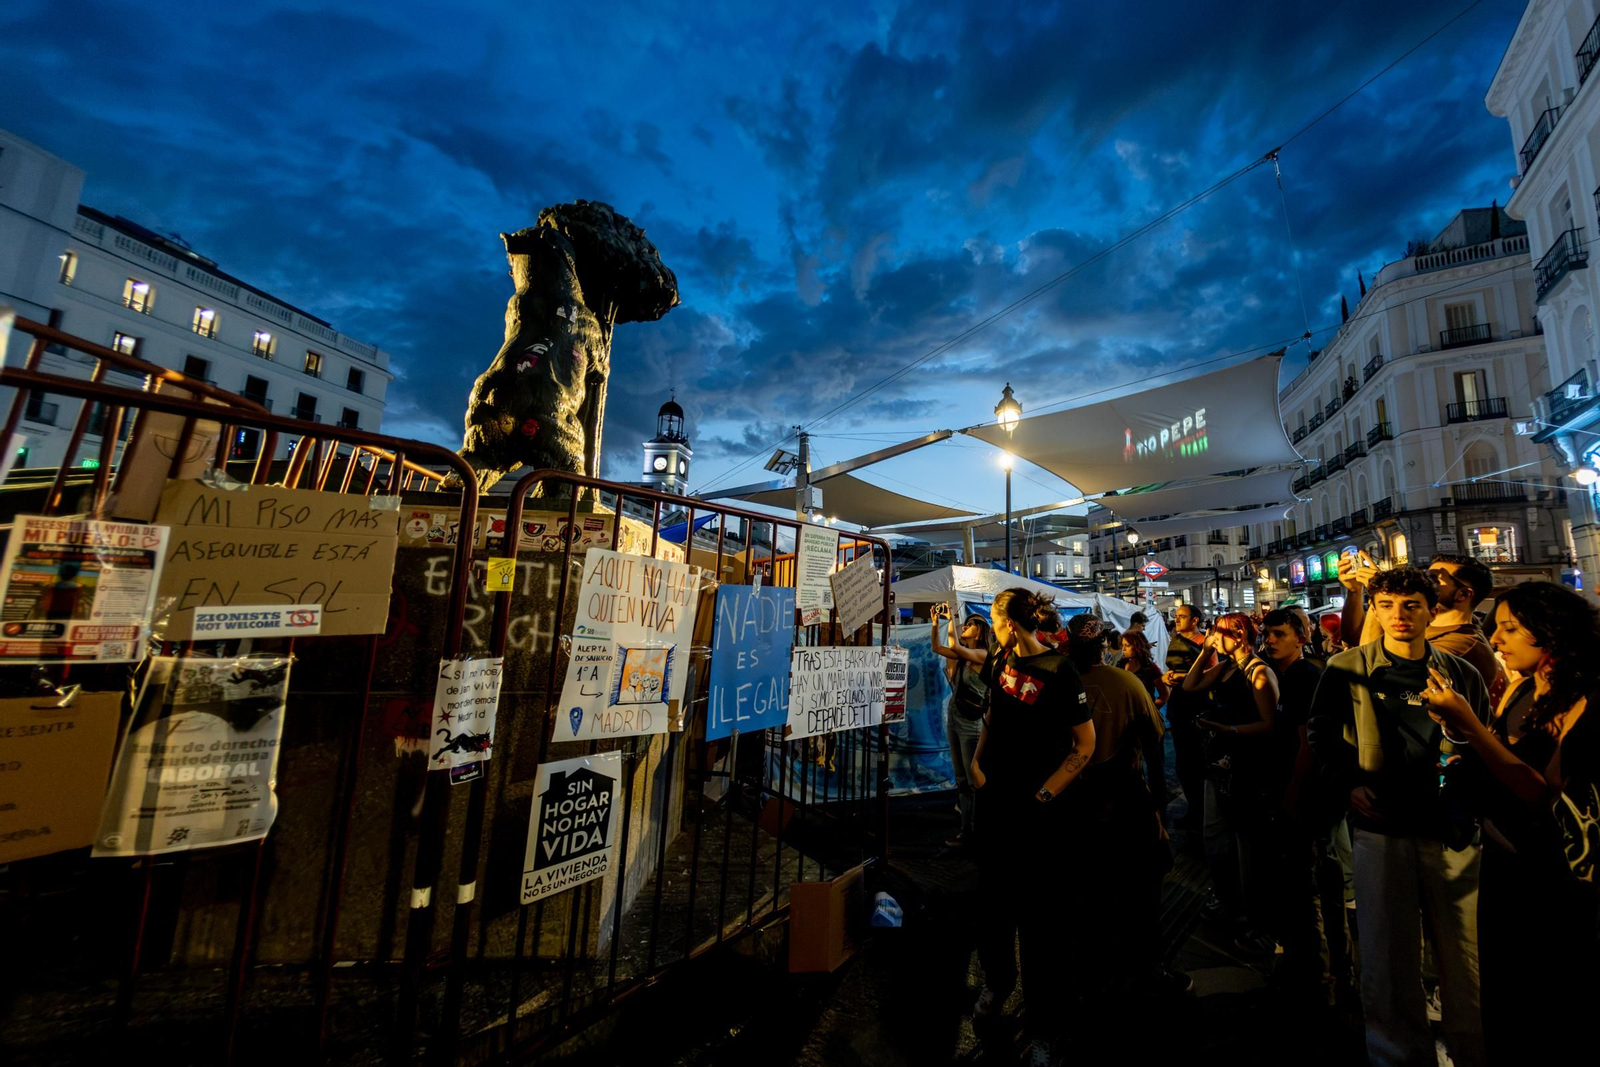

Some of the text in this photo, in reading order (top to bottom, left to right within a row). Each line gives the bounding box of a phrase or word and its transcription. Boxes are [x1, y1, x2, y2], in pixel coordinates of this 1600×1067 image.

[1160, 408, 1206, 451] PEPE
[184, 494, 230, 527] MI
[257, 498, 311, 528] PISO
[22, 529, 47, 542] MI
[143, 528, 157, 536] DE
[169, 541, 297, 562] ASEQUIBLE
[313, 540, 378, 562] ESTÁ
[178, 578, 240, 611] EN
[587, 555, 696, 606] AQUI NO HAY
[196, 612, 281, 622] ZIONISTS
[196, 621, 281, 631] NOT WELCOME
[588, 593, 675, 634] QUIEN VIVA
[716, 592, 795, 650] NADIE
[736, 651, 759, 670] ES
[795, 649, 883, 671] TRAS ESTA BARRICADA
[712, 676, 789, 729] ILEGAL
[591, 709, 653, 733] MADRID
[808, 701, 872, 734] DEPENDE DE TI
[182, 741, 205, 752] de
[148, 763, 260, 784] LABORAL
[567, 778, 594, 796] SIN
[545, 791, 610, 819] HOGAR
[542, 807, 609, 837] NO HAY
[542, 826, 603, 861] VIDA
[523, 864, 607, 900] NO ES UN NEGOCIO
[525, 853, 608, 890] LA VIVIENDA
